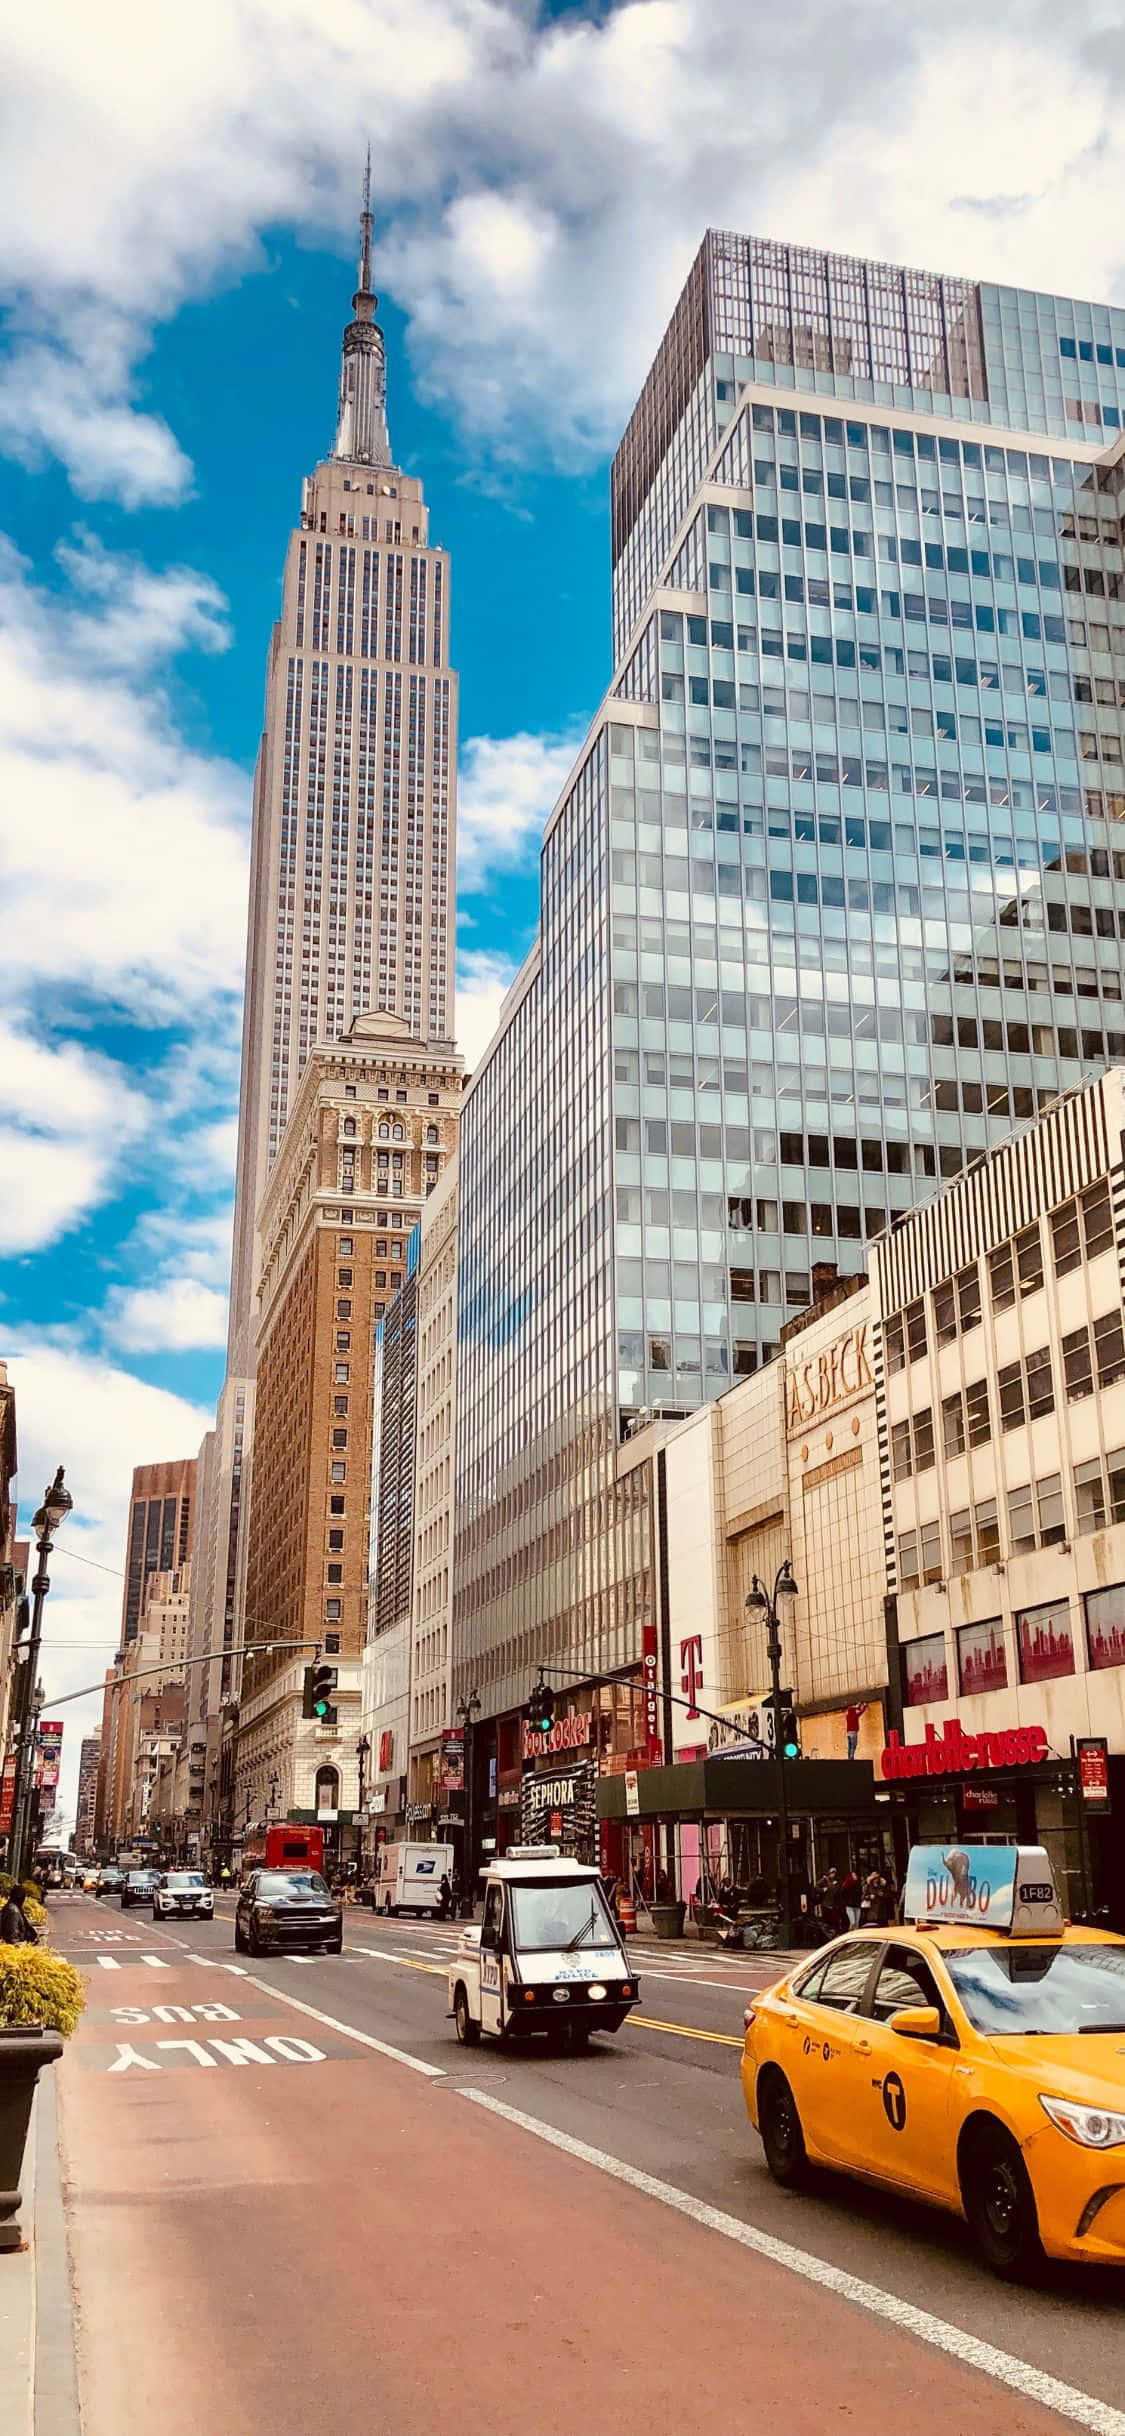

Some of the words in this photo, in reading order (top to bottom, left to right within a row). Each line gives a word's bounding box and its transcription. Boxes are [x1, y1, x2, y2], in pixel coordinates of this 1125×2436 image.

[680, 1634, 704, 1721] T
[647, 1668, 656, 1735] target
[881, 1719, 977, 1779] charlotte
[976, 1726, 1049, 1769] russe
[530, 1779, 575, 1810] SEPHORA
[966, 1789, 998, 1799] charlotte
[1021, 1886, 1051, 1900] 1F82
[109, 2002, 243, 2025] BUS
[107, 2036, 328, 2072] ONLY
